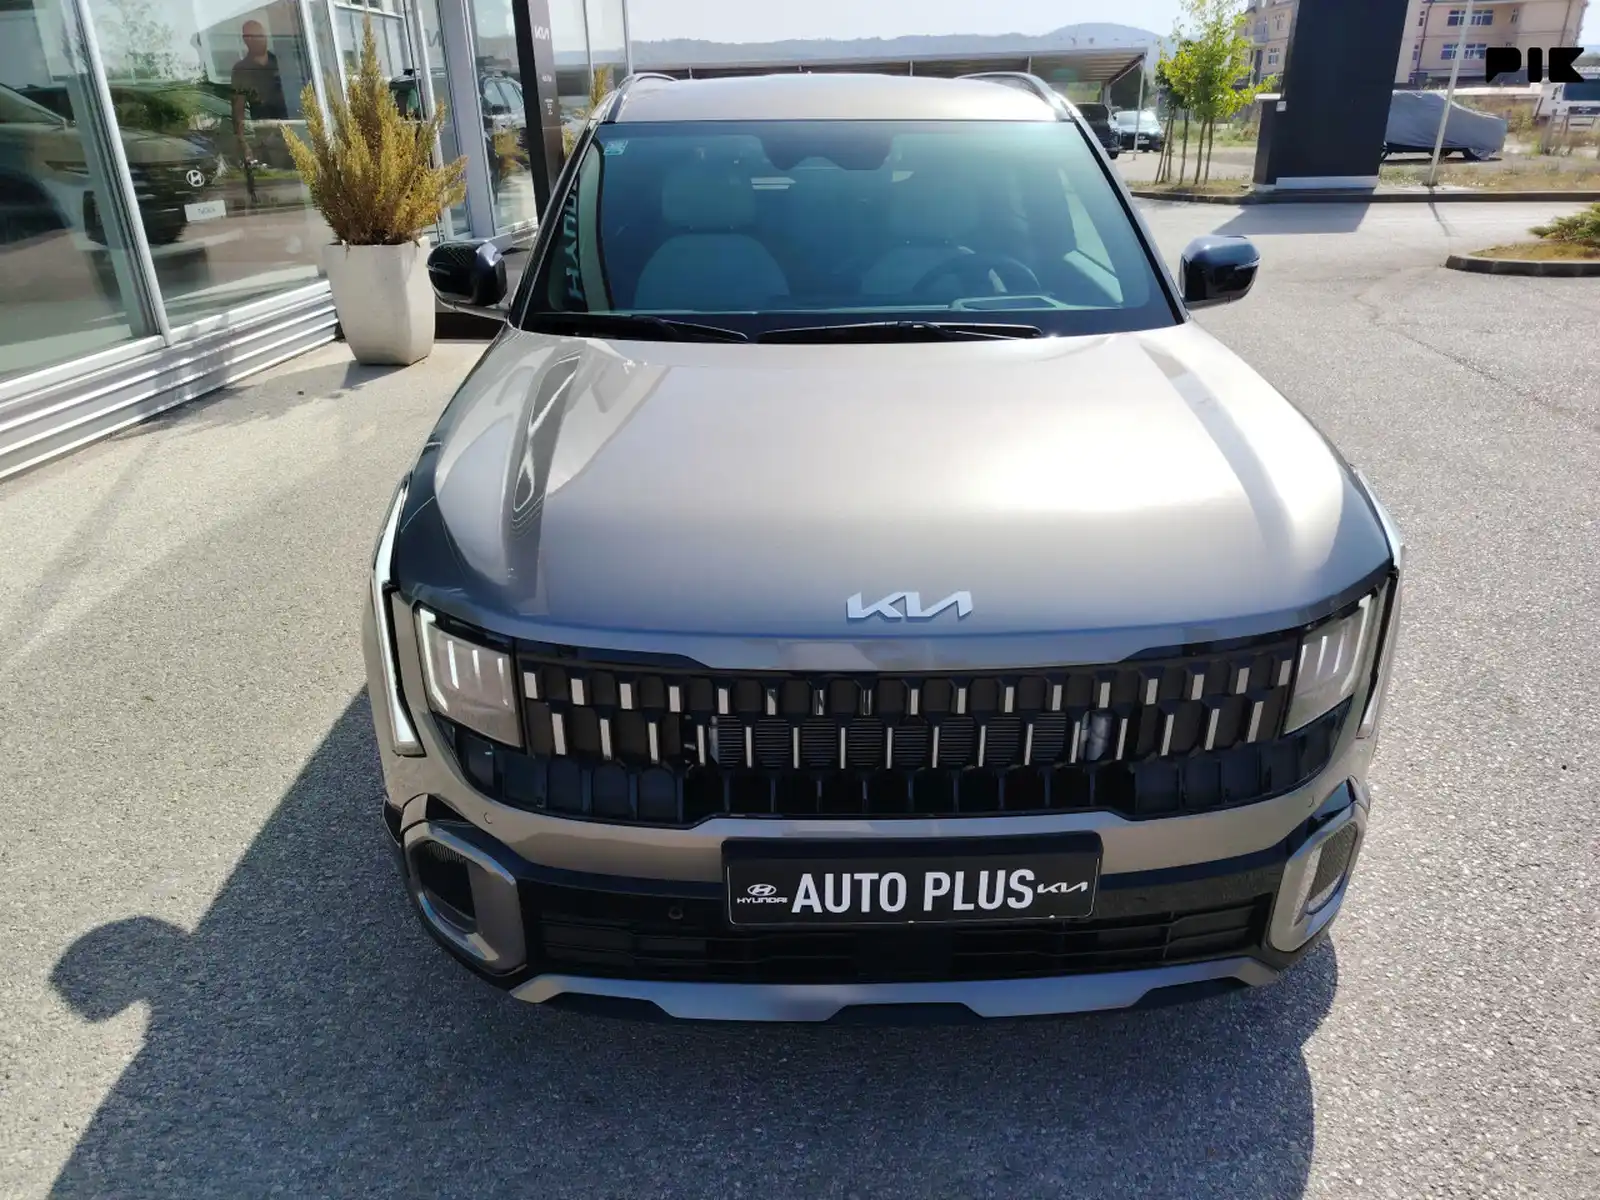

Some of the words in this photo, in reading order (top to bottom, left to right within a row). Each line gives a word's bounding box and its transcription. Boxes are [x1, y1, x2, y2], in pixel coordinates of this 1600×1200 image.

[846, 591, 973, 619] KIA
[791, 872, 907, 914] AUTO
[923, 868, 1035, 912] PLUS
[1037, 881, 1088, 894] KIA
[737, 896, 788, 904] HYUNDAI
